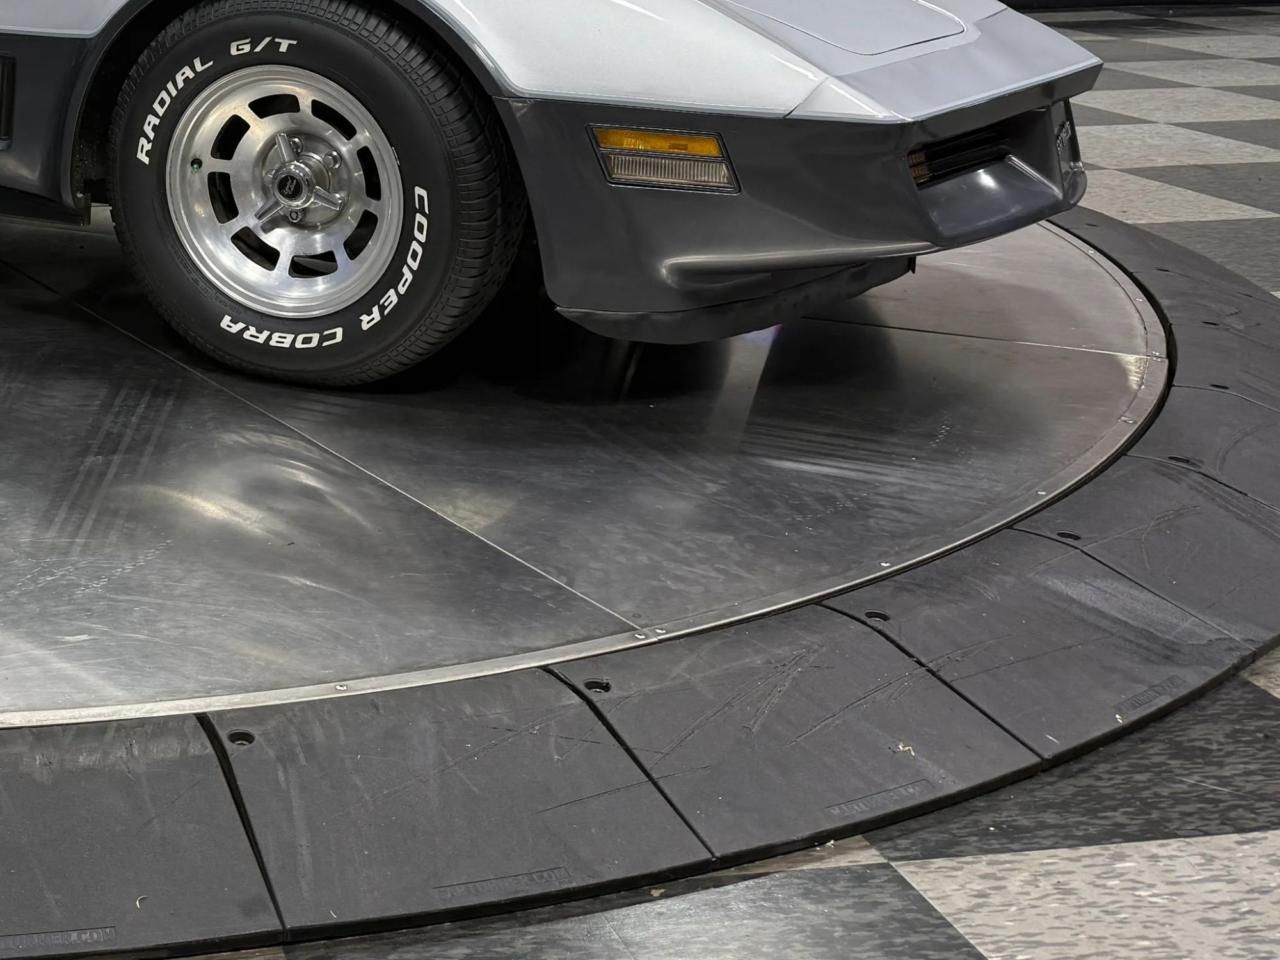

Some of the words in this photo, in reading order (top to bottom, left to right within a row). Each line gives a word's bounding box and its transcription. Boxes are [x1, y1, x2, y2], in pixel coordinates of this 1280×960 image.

[136, 57, 214, 165] RADIAL
[230, 36, 298, 56] G/T
[361, 186, 429, 332] COOPER
[220, 315, 343, 349] COBRA
